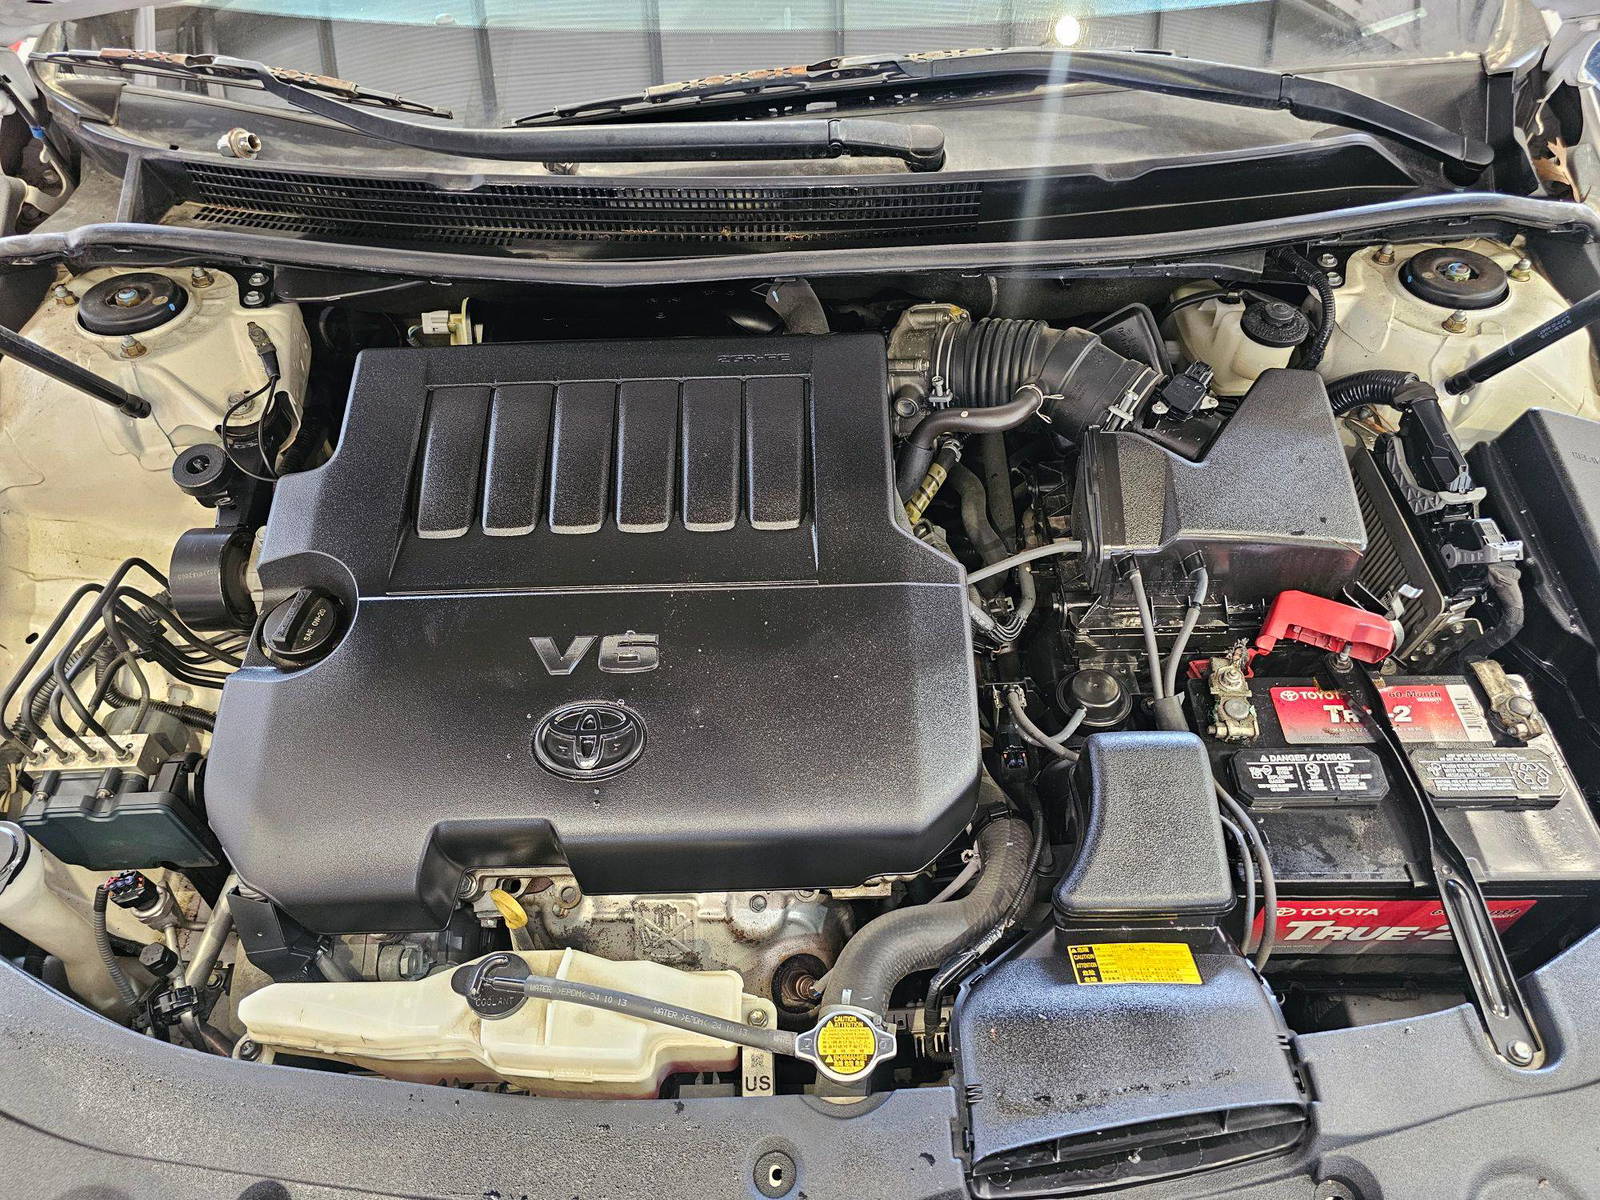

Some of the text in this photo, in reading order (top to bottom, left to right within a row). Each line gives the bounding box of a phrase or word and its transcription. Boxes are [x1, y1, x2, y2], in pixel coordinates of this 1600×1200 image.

[303, 628, 315, 642] SAE
[529, 631, 659, 675] V6
[1300, 691, 1343, 700] TOYOT
[1316, 753, 1351, 761] POISON
[1301, 908, 1378, 916] TOYOTA
[529, 983, 552, 994] WATER
[475, 996, 515, 1007] COOLANT
[653, 1006, 678, 1020] WATER
[745, 1075, 771, 1091] US
